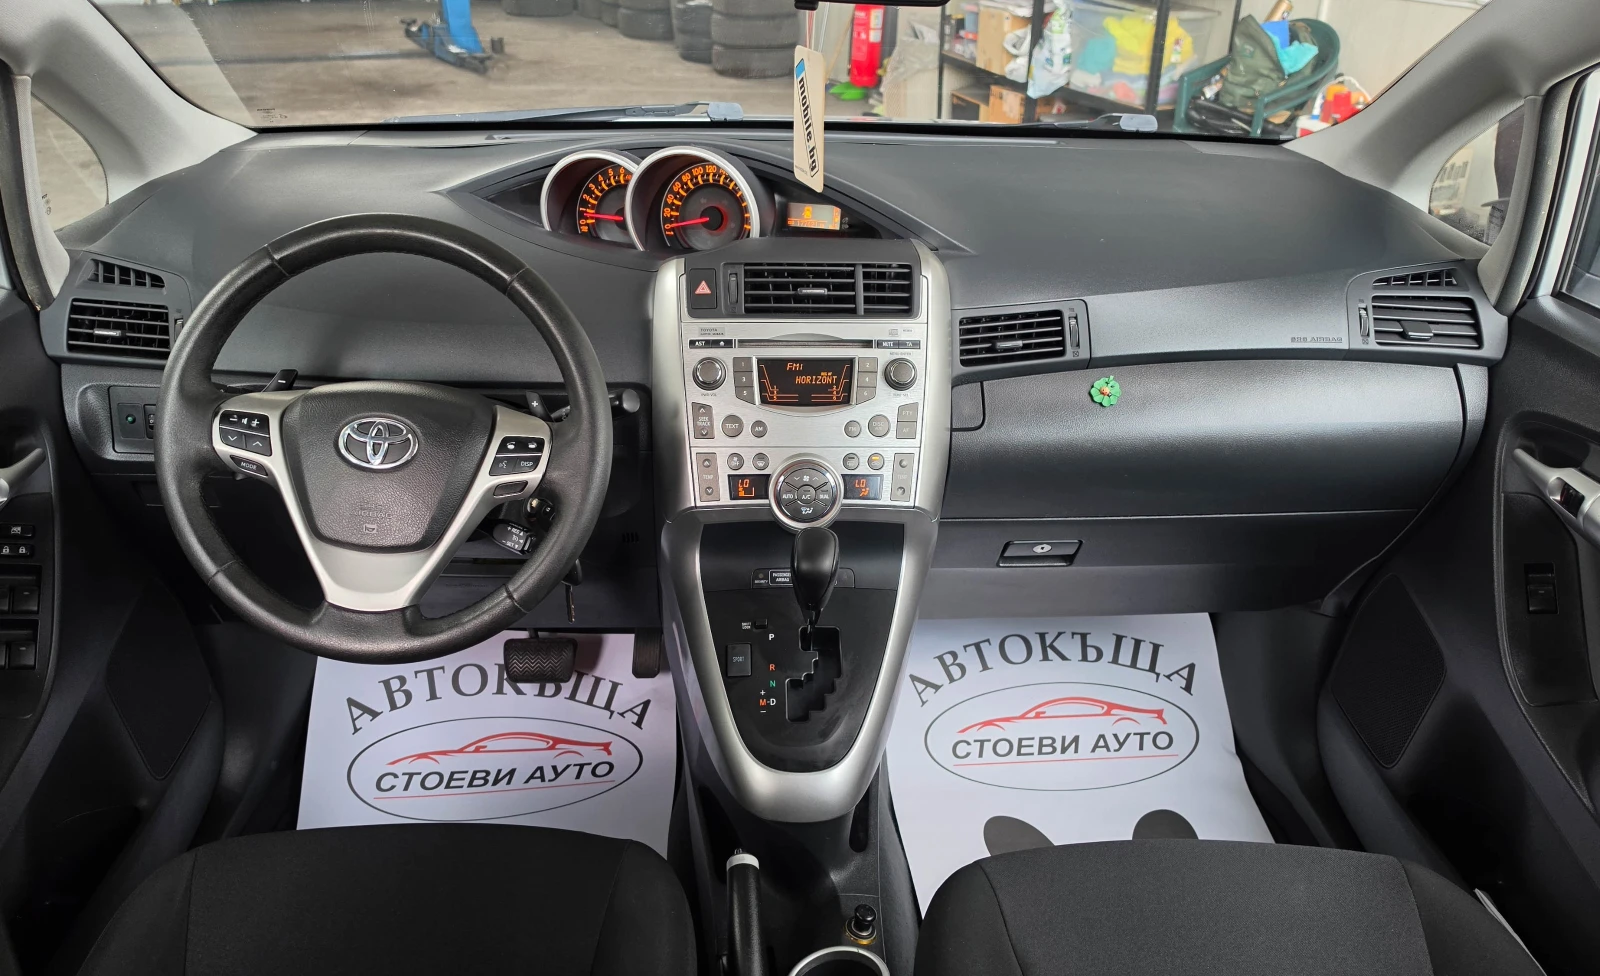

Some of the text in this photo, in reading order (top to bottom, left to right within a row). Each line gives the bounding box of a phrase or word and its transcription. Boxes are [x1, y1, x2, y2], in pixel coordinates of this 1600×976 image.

[607, 168, 614, 176] 5
[619, 166, 625, 174] 6
[692, 167, 704, 176] 100
[706, 165, 717, 173] 120
[598, 174, 604, 182] 4
[681, 172, 691, 183] 80
[588, 183, 596, 191] 3
[672, 181, 682, 192] 60
[582, 193, 591, 202] 2
[666, 193, 675, 204] 40
[663, 207, 671, 218] 20
[786, 362, 804, 371] FM1
[795, 375, 837, 384] HORIZONT
[240, 461, 257, 470] MODE
[768, 633, 775, 641] P
[769, 663, 776, 671] R
[908, 631, 1197, 708] АВТОКЪЩА
[951, 730, 1175, 760] СТОЕВИ АУТО
[374, 760, 616, 793] СТОЕВИ АУТО
